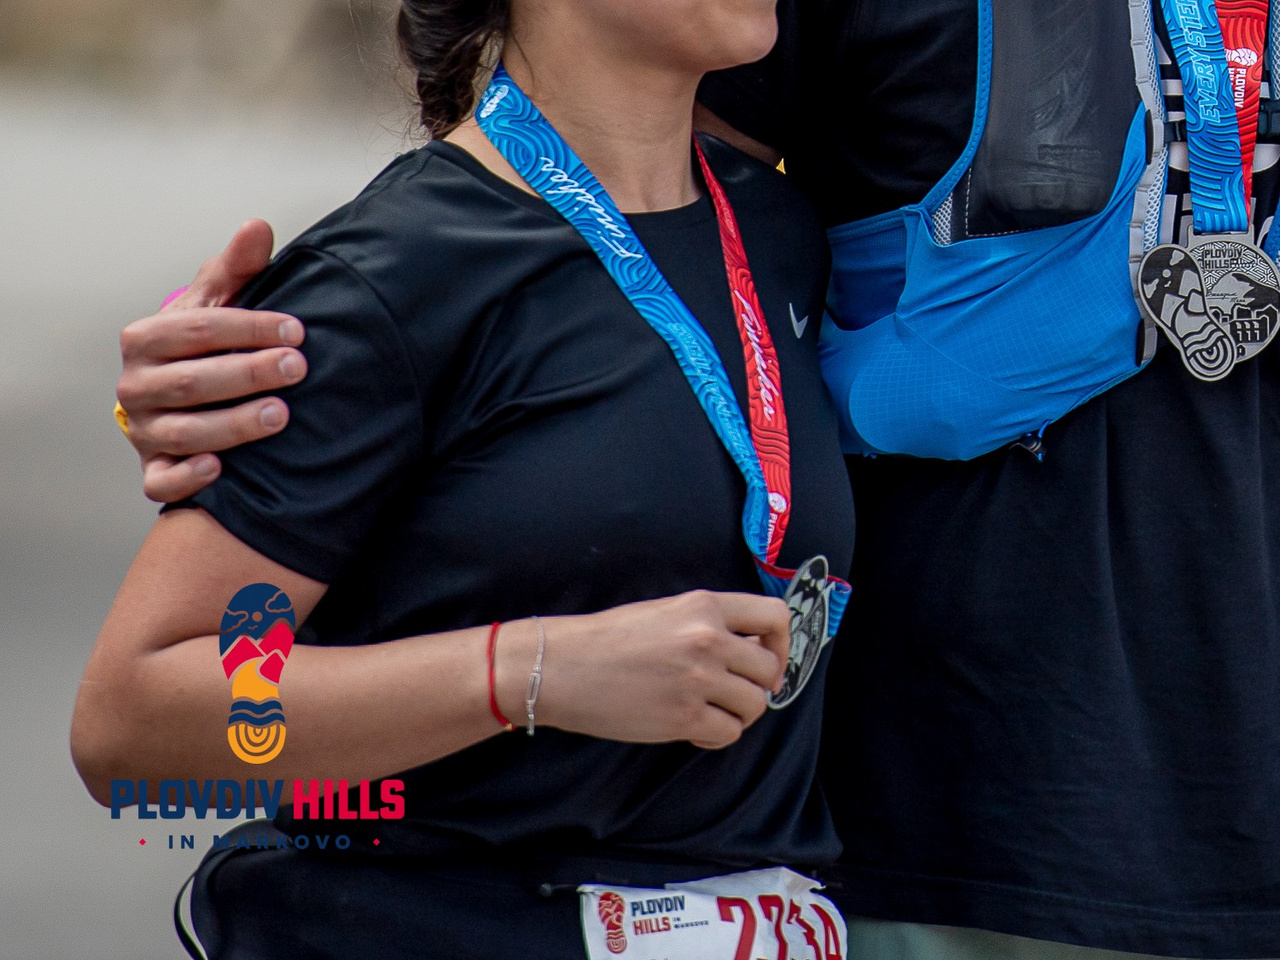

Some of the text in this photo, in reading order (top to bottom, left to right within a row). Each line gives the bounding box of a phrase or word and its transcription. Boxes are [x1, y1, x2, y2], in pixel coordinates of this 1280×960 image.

[1187, 47, 1222, 124] EVERY
[1233, 68, 1247, 108] PLOVDIV
[539, 156, 644, 259] Finisher
[1204, 249, 1242, 258] PLOVDIV
[1204, 259, 1230, 269] HILLS
[630, 895, 686, 918] PLOVDIV
[632, 916, 672, 936] HILLS
